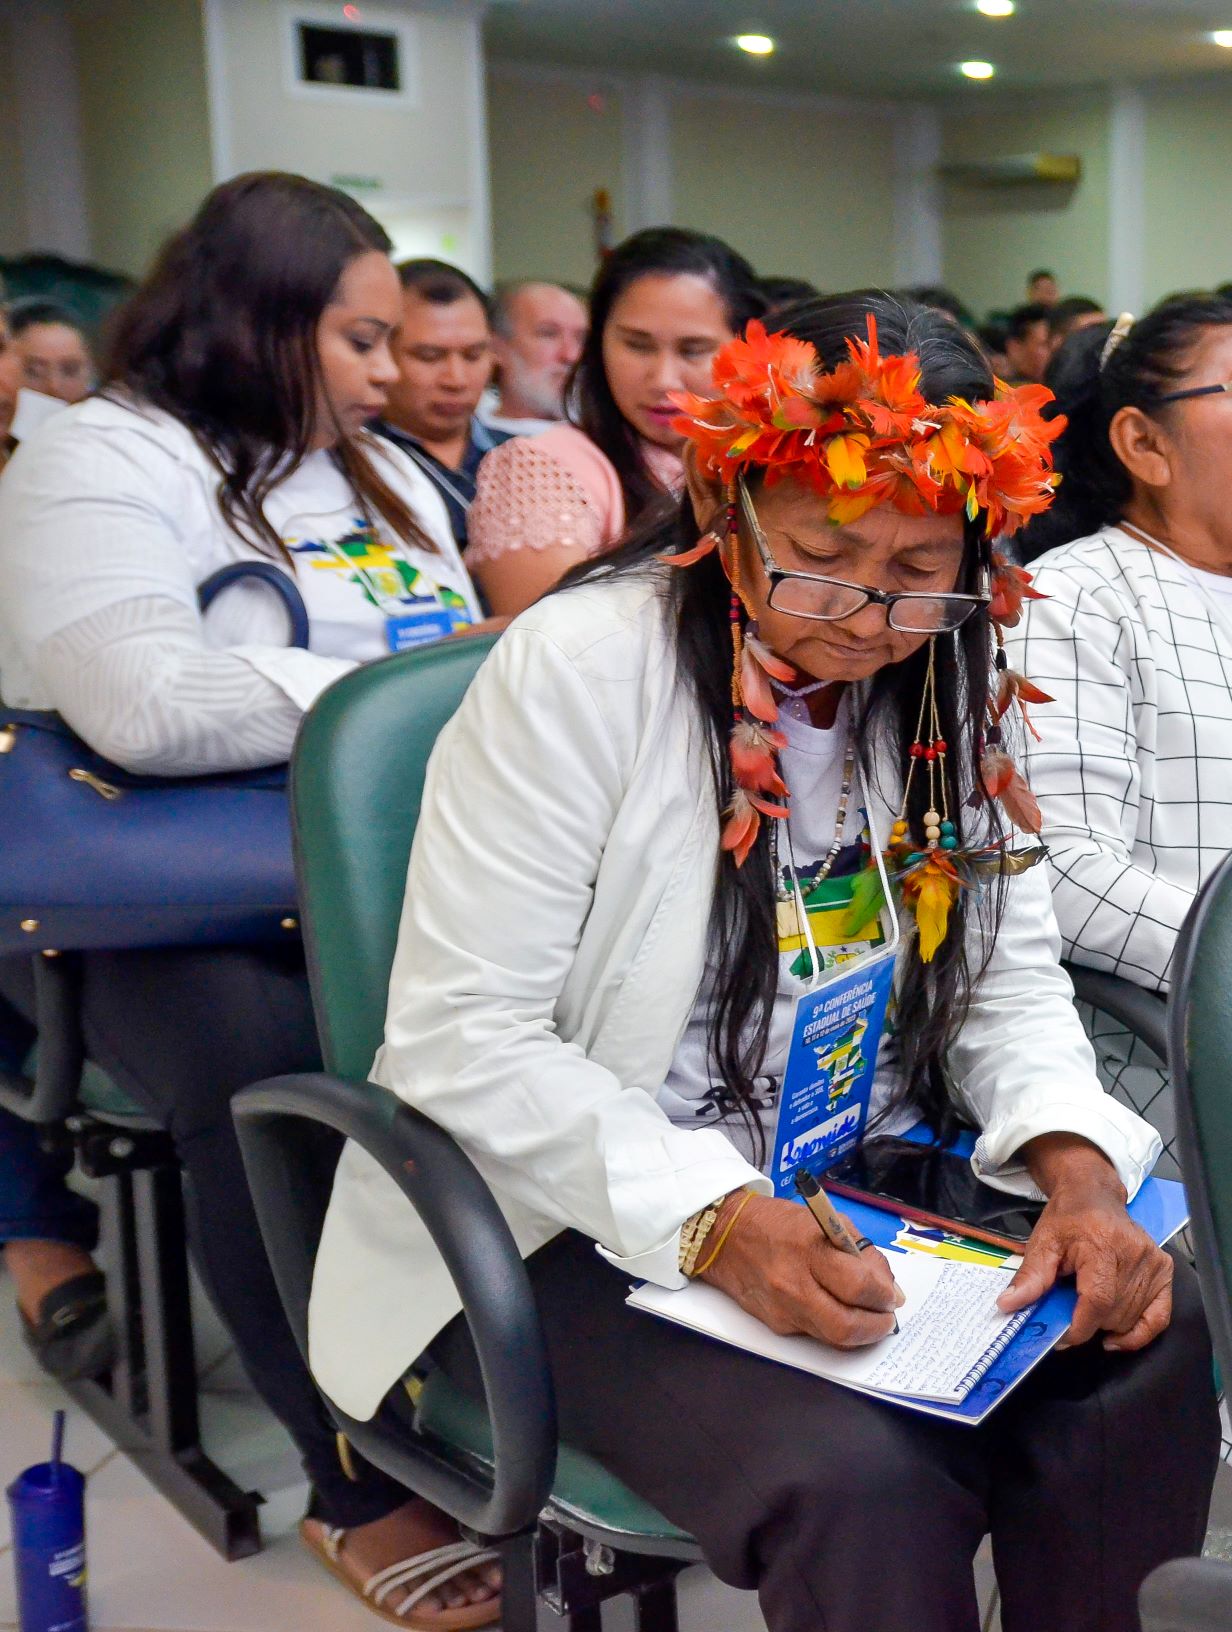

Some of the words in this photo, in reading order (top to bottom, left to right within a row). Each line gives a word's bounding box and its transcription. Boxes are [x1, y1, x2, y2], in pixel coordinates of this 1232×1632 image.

[803, 1010, 840, 1037] ESTADUAL
[841, 1004, 852, 1019] DE
[852, 992, 877, 1013] SAÚDE
[812, 1003, 824, 1018] 9ª
[824, 979, 873, 1012] CONFERÊNCIA
